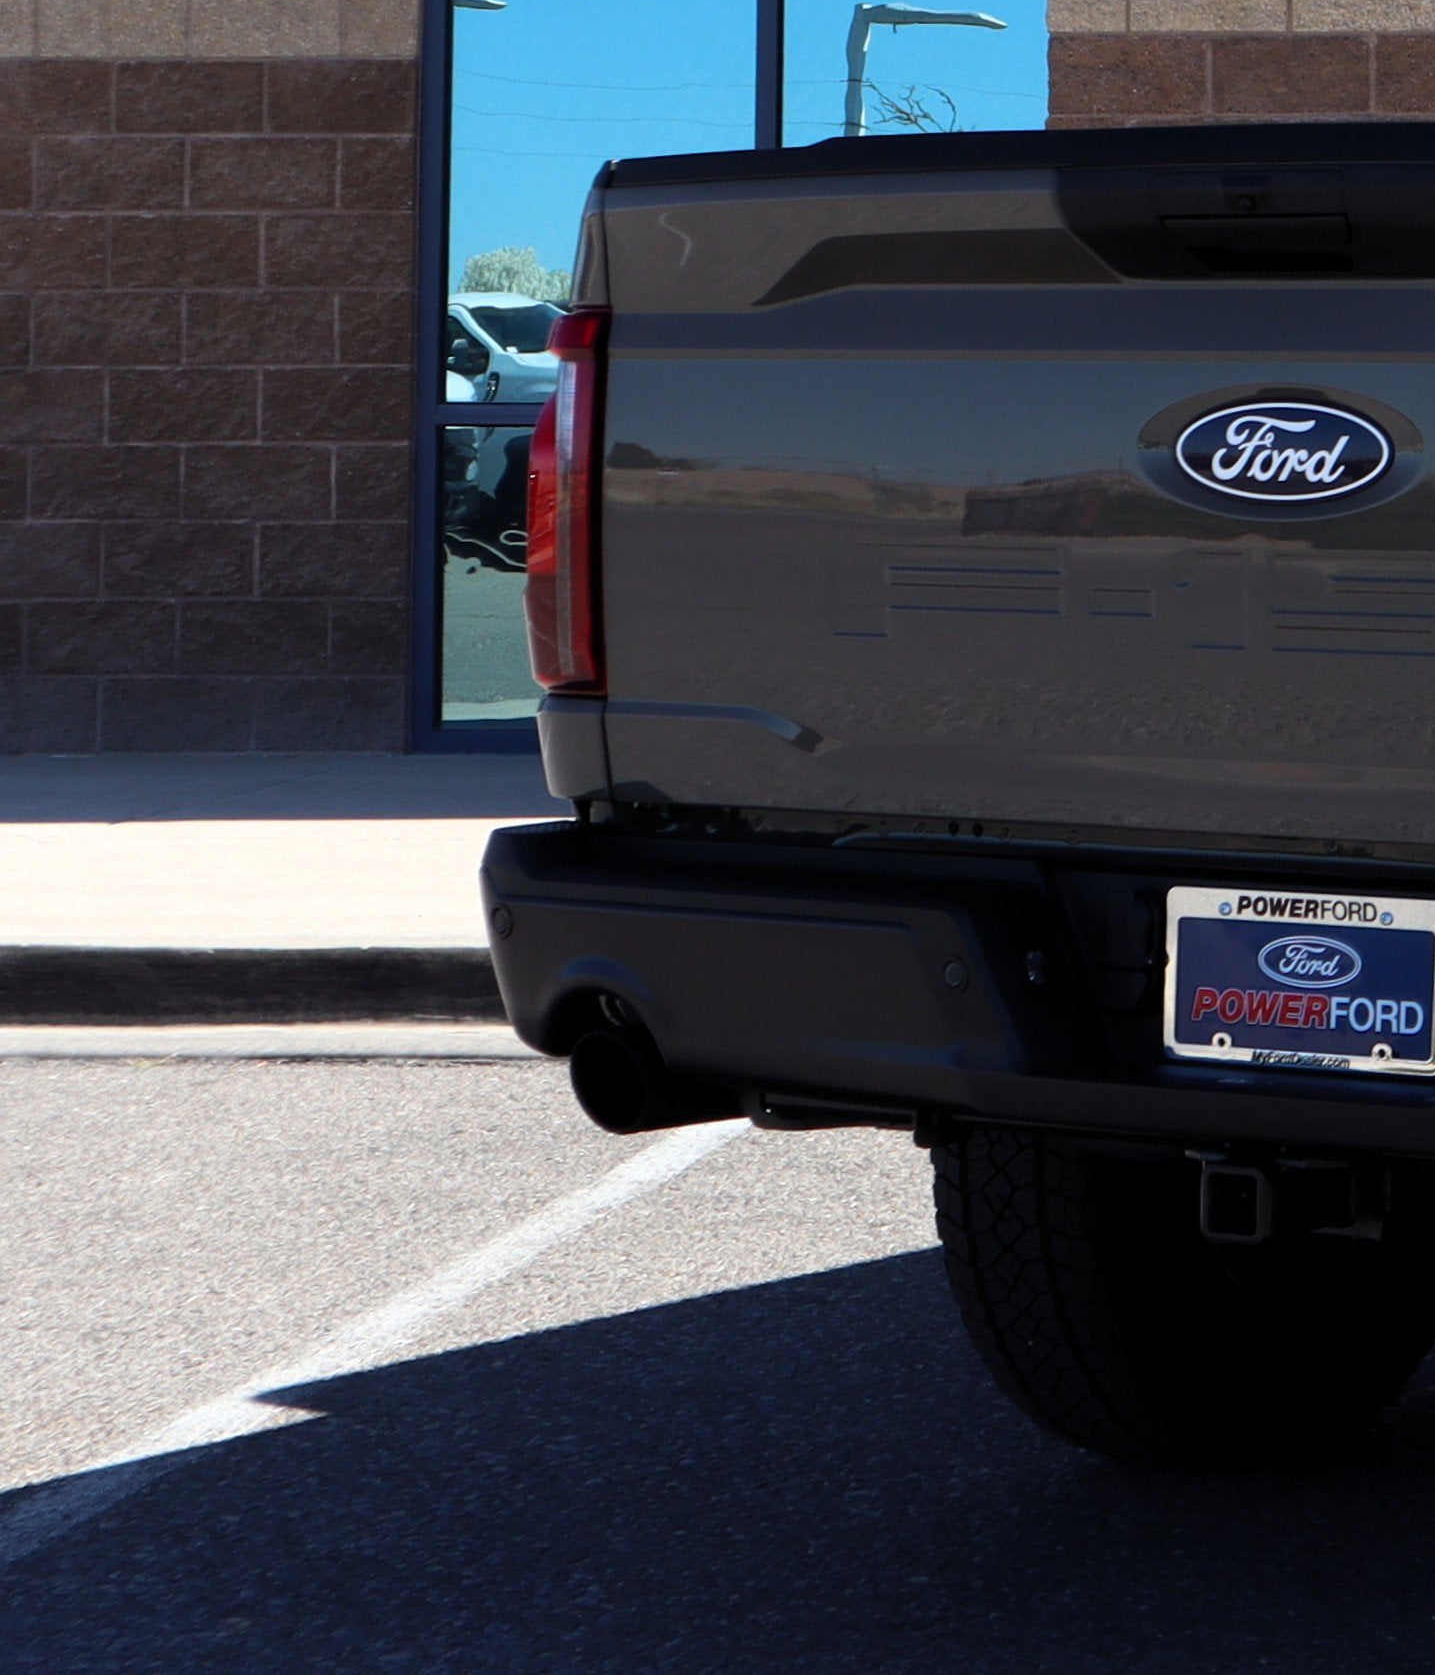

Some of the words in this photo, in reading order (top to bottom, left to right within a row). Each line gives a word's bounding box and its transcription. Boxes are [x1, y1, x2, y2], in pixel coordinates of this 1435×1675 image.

[1211, 415, 1350, 483] Ford
[1236, 895, 1378, 923] POWERFORD
[1278, 943, 1341, 977] Ford
[1192, 987, 1424, 1034] POWERFORD
